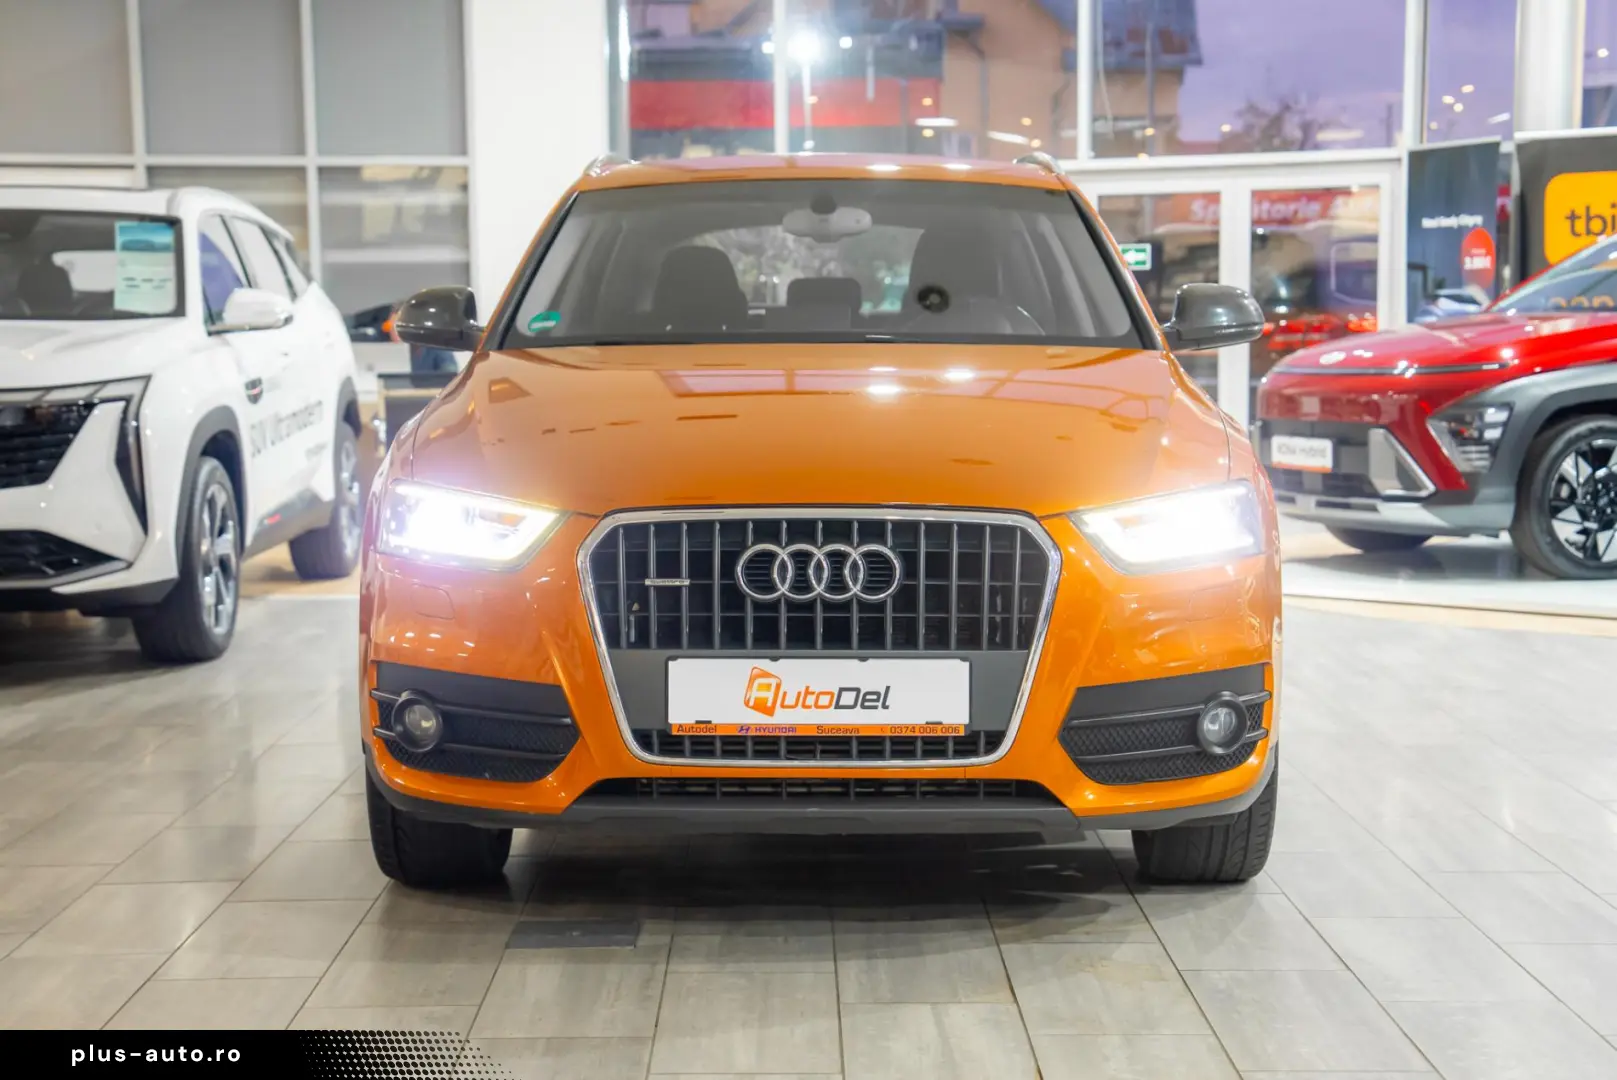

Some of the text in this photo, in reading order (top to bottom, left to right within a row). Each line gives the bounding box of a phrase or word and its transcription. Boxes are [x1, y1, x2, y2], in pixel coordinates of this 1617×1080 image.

[1564, 202, 1617, 238] tbi
[744, 668, 891, 716] AutoDel
[677, 724, 961, 735] Autodel HYUNDAI Suceava 0374 006 006
